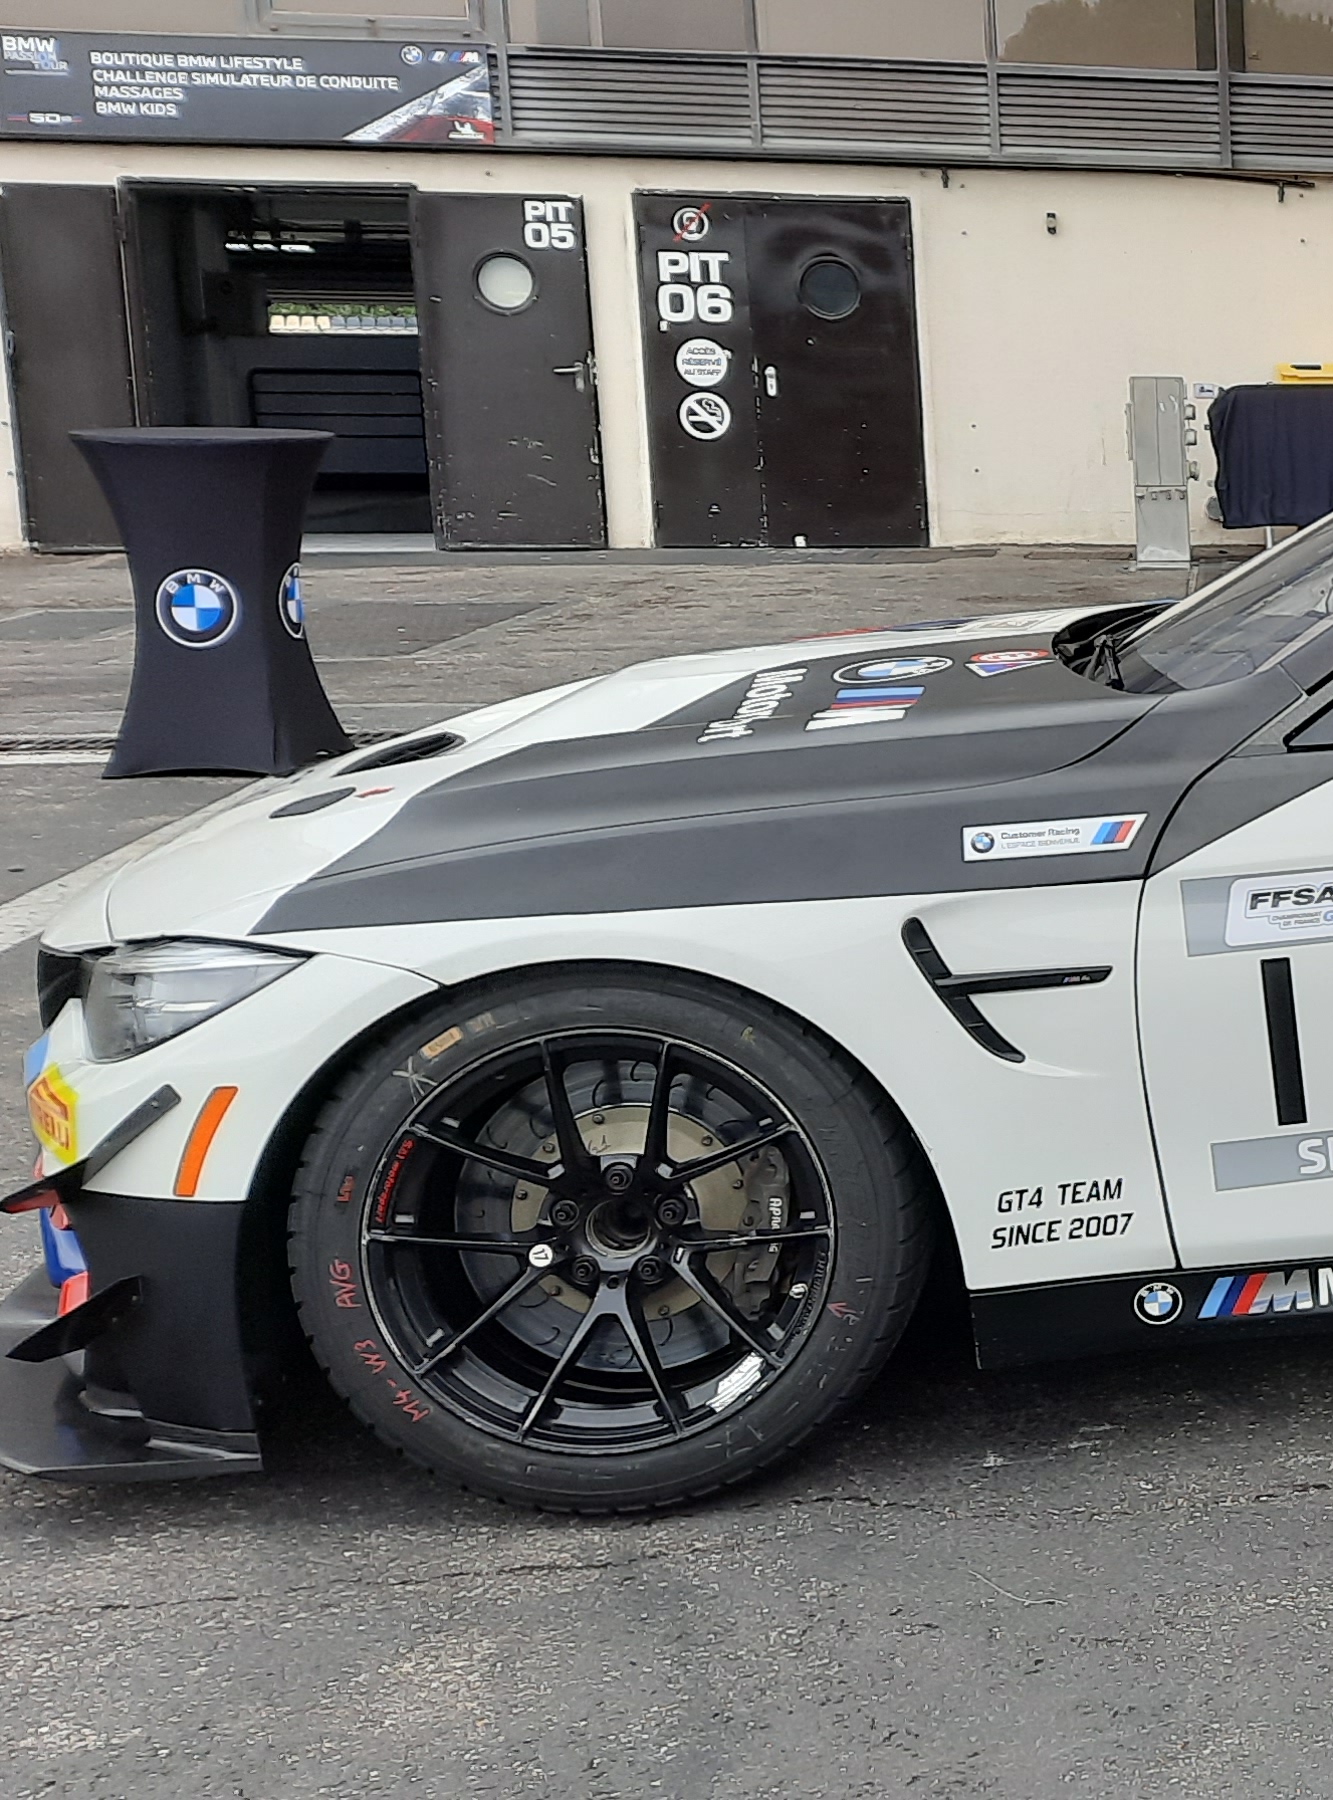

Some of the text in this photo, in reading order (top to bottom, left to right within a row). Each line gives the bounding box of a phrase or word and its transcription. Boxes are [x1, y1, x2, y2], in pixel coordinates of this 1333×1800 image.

[1, 35, 56, 52] BMW
[32, 59, 69, 70] TOUR
[90, 51, 303, 71] BOUTIQUE BMW LIFESTYLE
[92, 69, 399, 90] CHALLENGE SIMULATEUR DE CONDUITE
[94, 85, 184, 99] MASSAGES
[95, 102, 177, 116] BMW KIDS
[524, 201, 575, 223] PIT
[524, 222, 576, 249] 05
[657, 251, 730, 282] PIT
[658, 283, 733, 322] 06
[997, 1177, 1124, 1214] GT4 TEAM
[990, 1211, 1135, 1250] SINCE 2007
[335, 1259, 361, 1310] AVG
